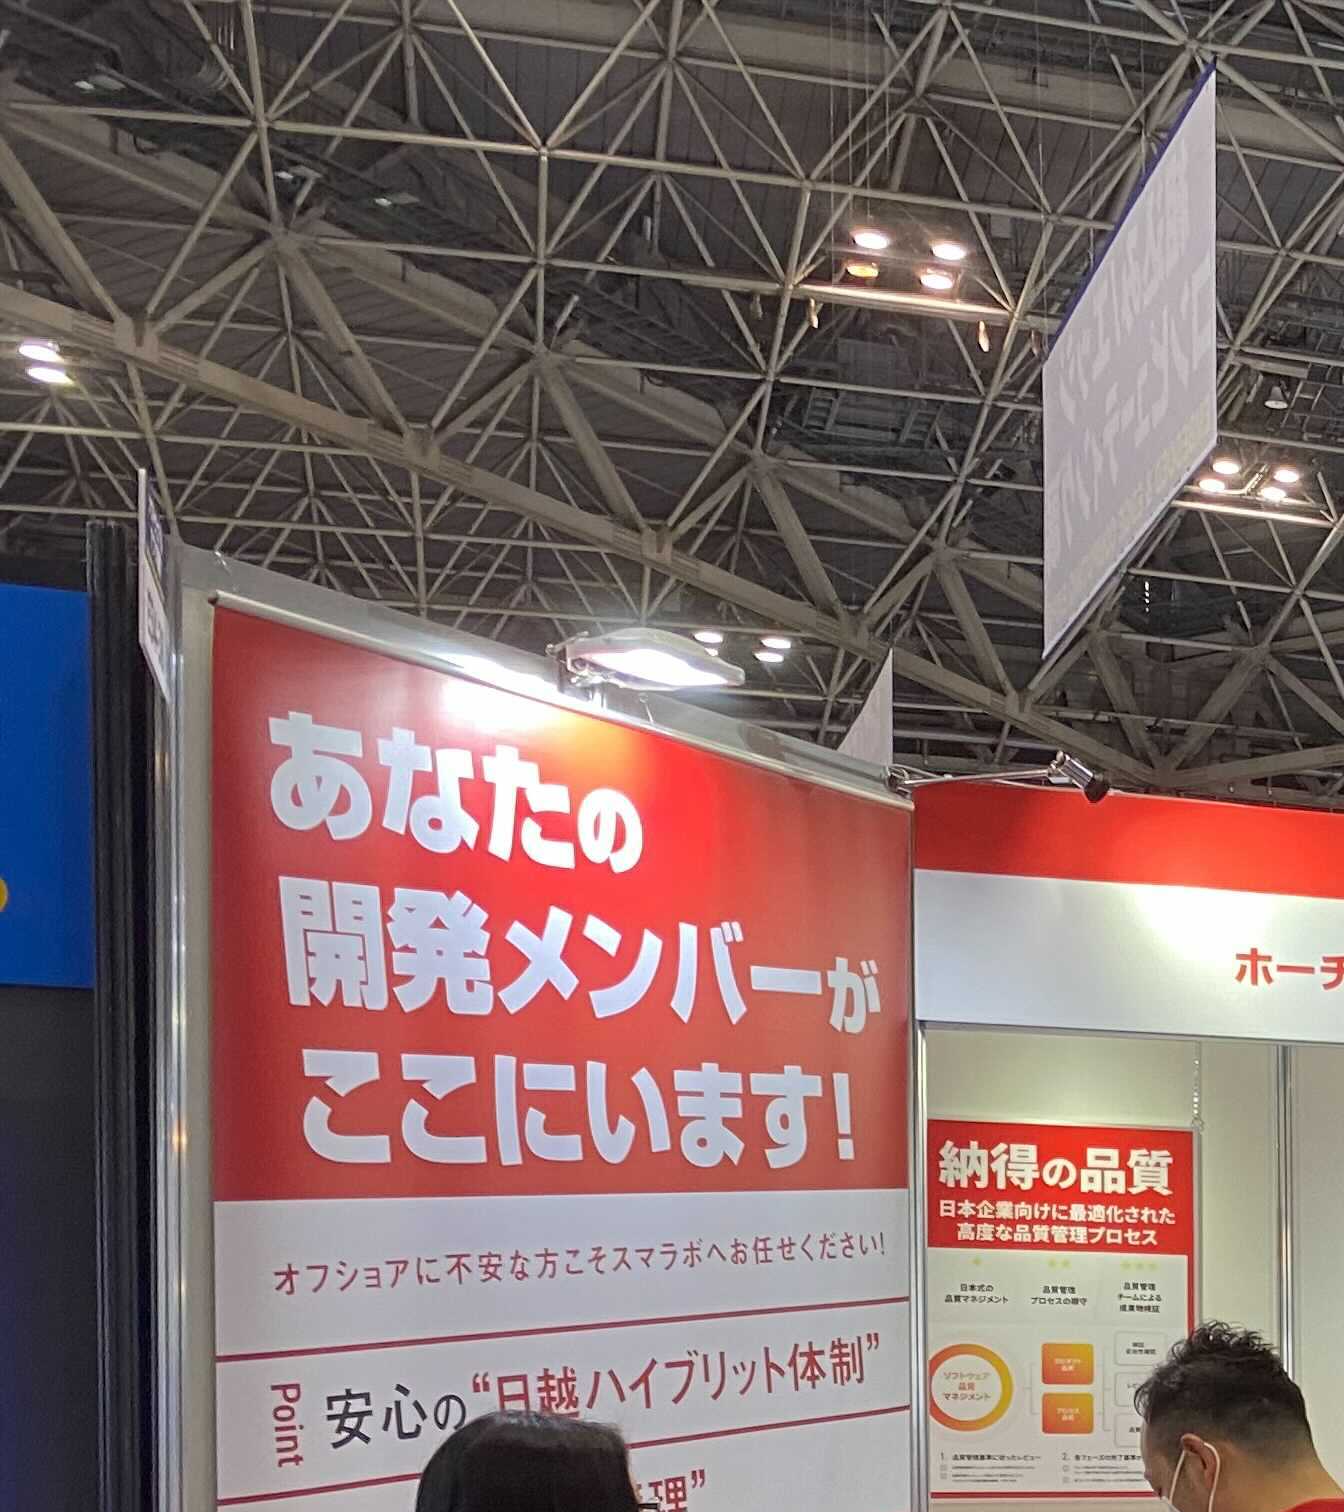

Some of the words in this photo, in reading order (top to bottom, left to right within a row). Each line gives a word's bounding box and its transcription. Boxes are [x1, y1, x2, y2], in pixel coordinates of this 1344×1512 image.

[268, 710, 643, 874] あなたの
[278, 875, 882, 1036] 開発メンバーが
[300, 1048, 855, 1169] ここにいます!
[938, 1140, 1174, 1196] 納得の品質
[939, 1199, 1176, 1225] 日本企業向けに最適化された
[957, 1222, 1158, 1246] 高度な品質管理プロセス
[273, 1230, 887, 1297] オフショアに不安な方こそスマラボへお任せください!
[270, 1382, 304, 1469] Point
